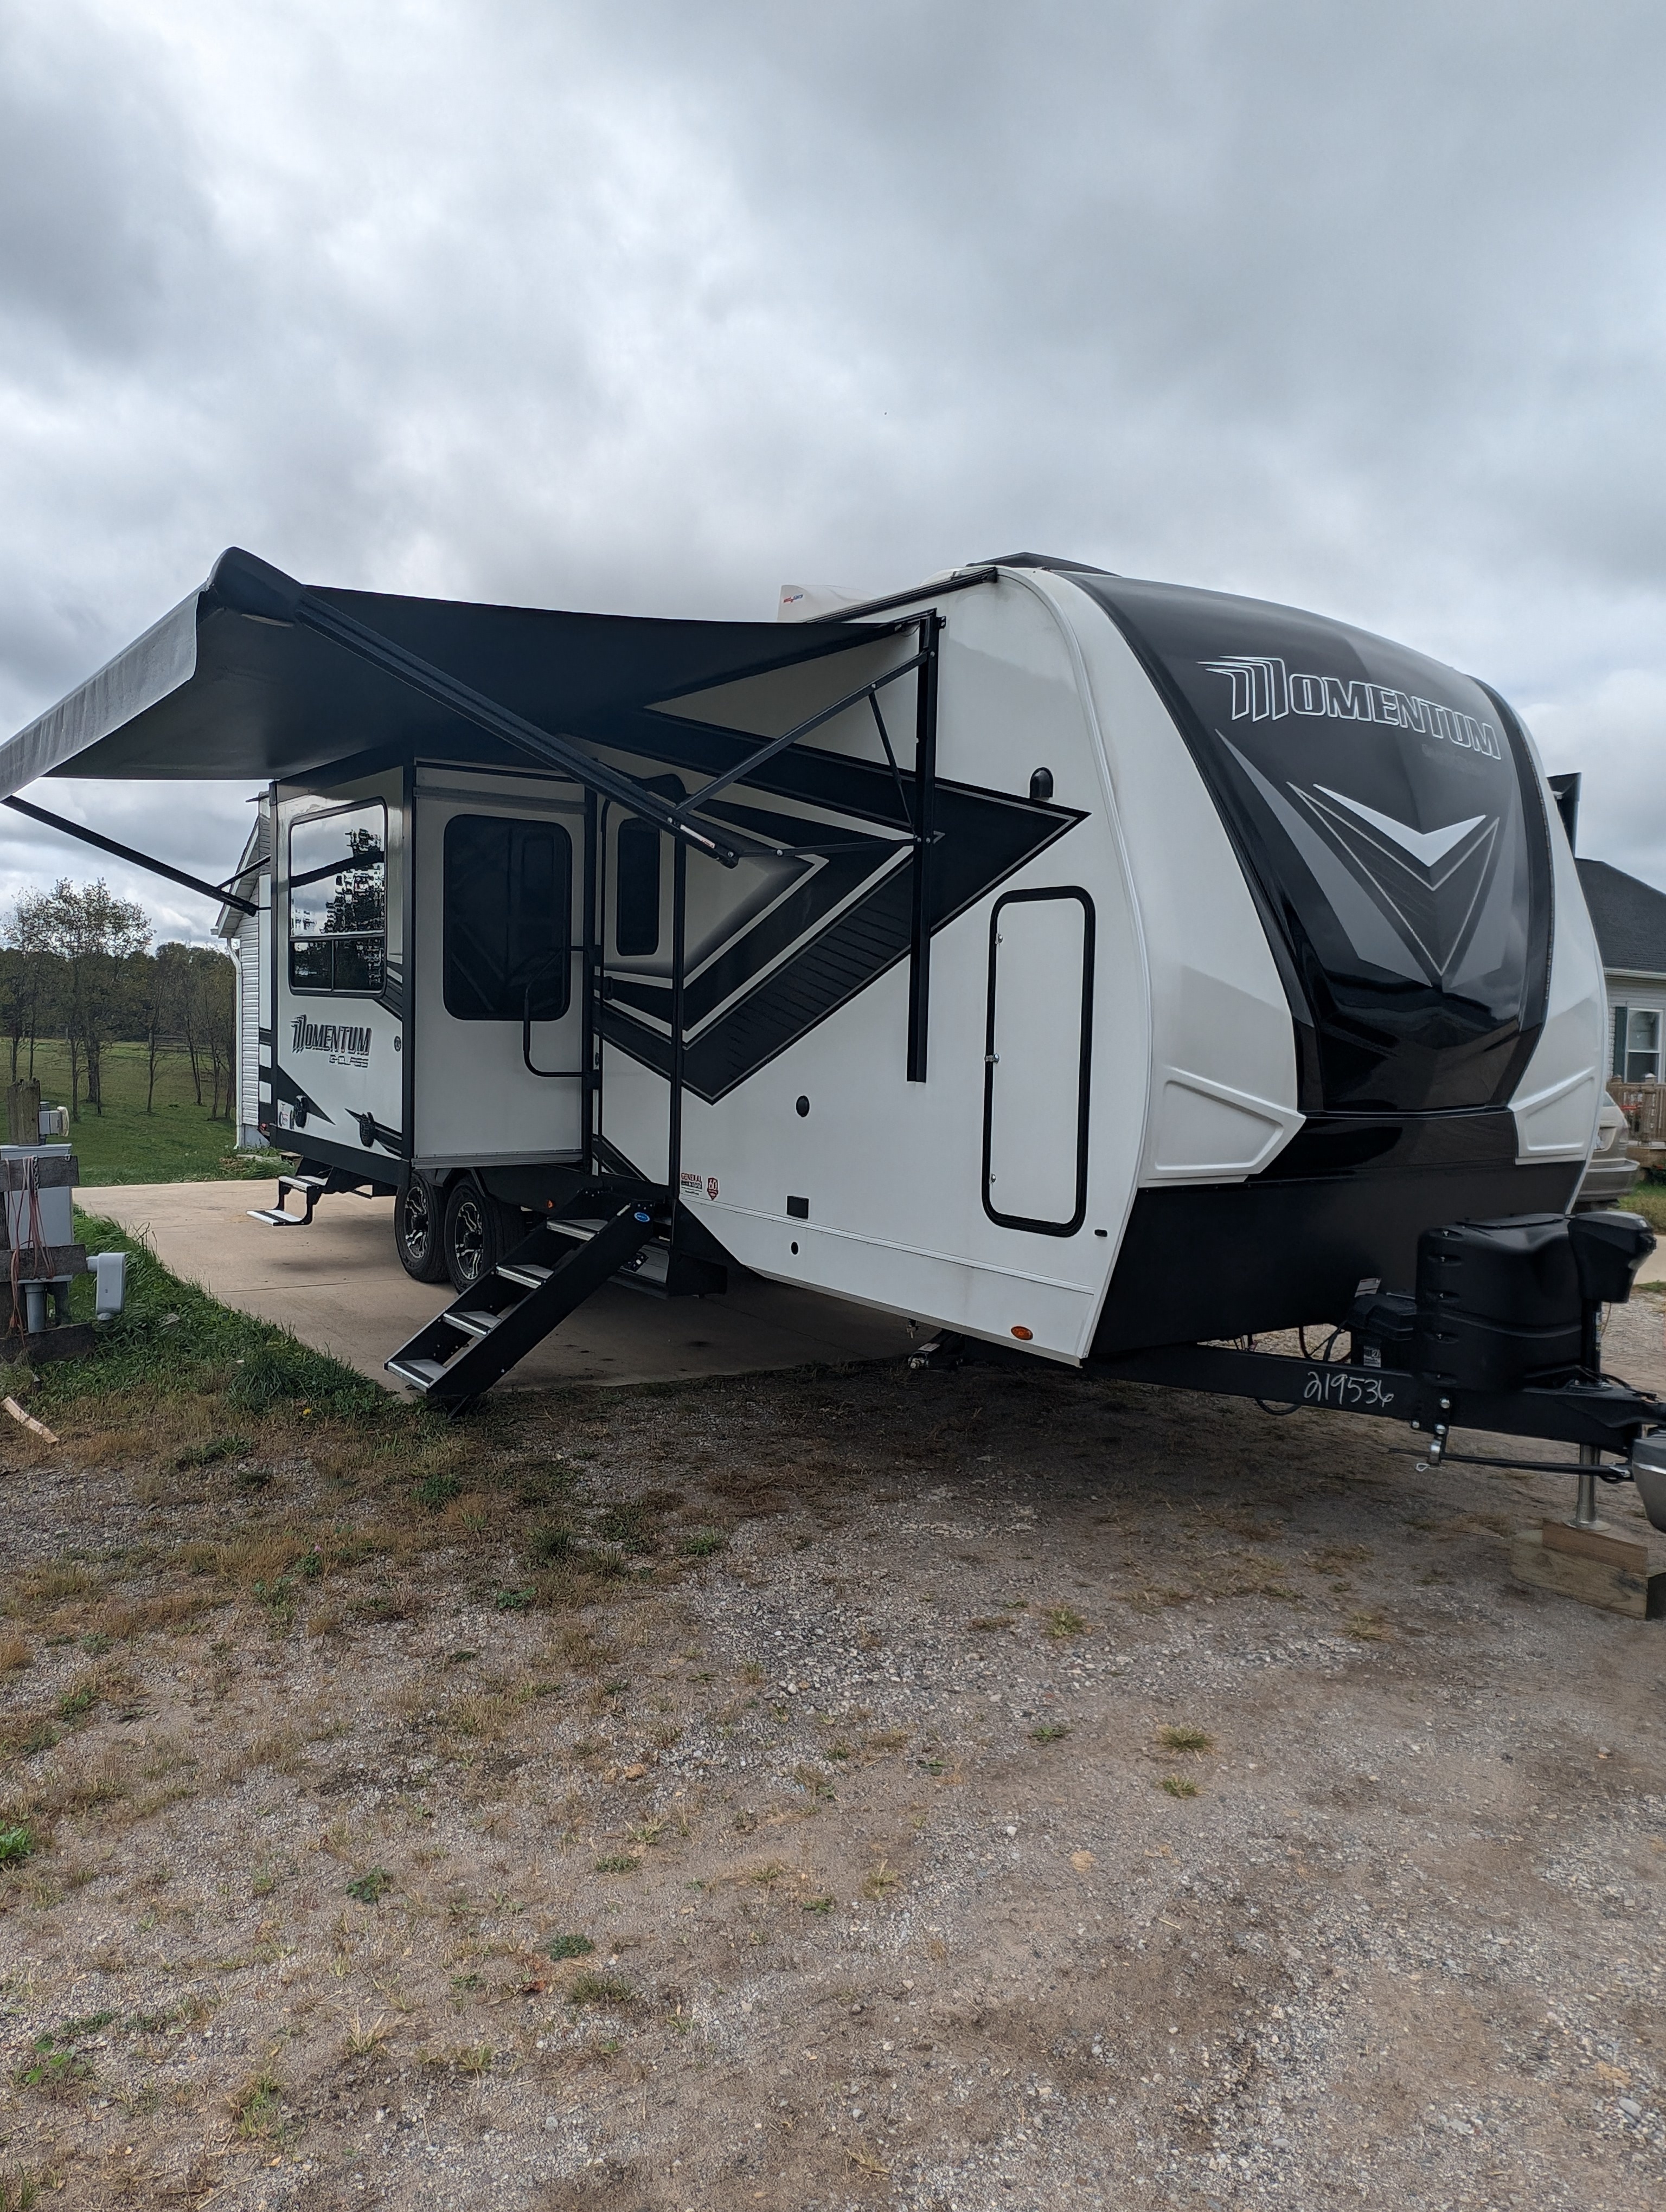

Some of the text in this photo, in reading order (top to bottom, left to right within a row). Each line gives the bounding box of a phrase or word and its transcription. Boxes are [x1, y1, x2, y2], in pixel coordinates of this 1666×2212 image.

[1196, 655, 1501, 760] MOMENTUM
[290, 1014, 372, 1056] MOMENTUM
[1303, 1371, 1394, 1407] 219536
